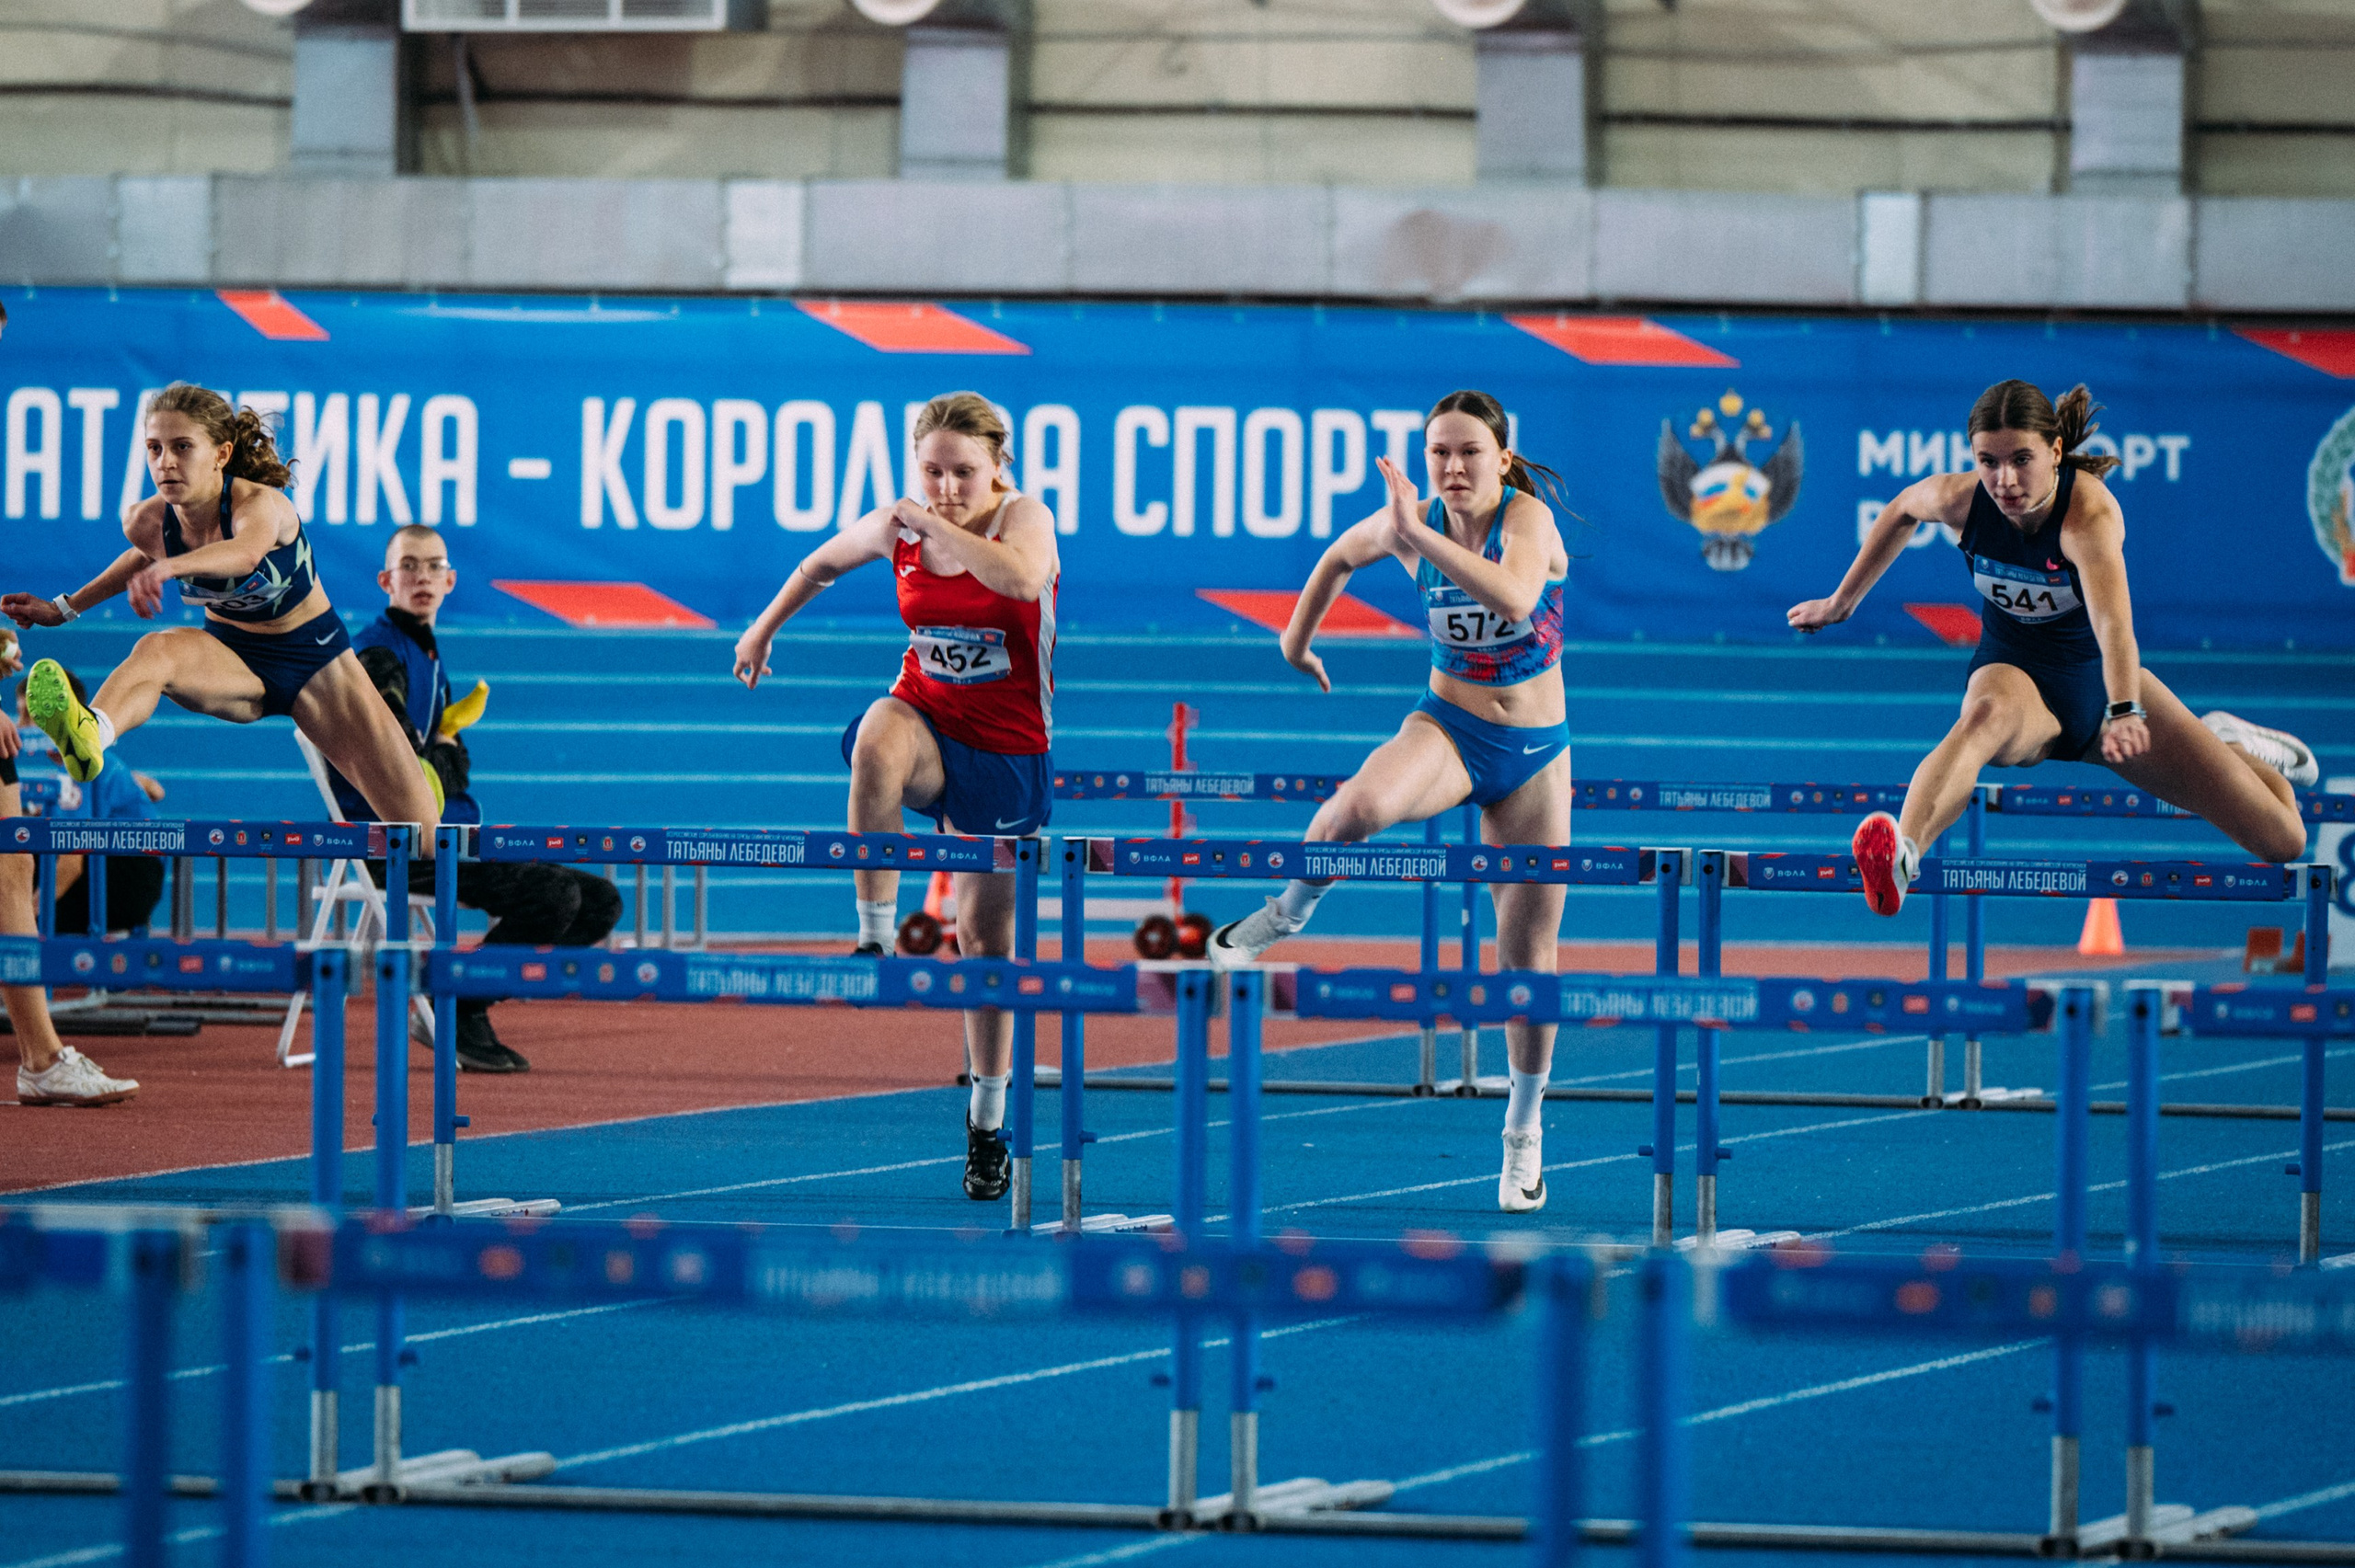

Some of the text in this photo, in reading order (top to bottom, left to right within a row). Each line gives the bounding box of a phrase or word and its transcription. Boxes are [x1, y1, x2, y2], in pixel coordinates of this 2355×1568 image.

[580, 396, 1082, 535] КОРОЛА
[1857, 429, 2191, 482] МИНОРТ
[205, 595, 266, 609] 03
[1992, 583, 2059, 612] 541
[1447, 612, 1515, 642] 572
[930, 644, 991, 673] 452
[51, 829, 185, 852] ТАТЬЯНЫ ЛЕБЕДЕВОЙ
[666, 841, 805, 864] ТАТЬЯНЫ ЛЕБЕДЕВОЙ
[1305, 855, 1447, 879] ТАТЬЯНЫ ЛЕБЕДЕВОЙ
[1943, 869, 2086, 892] ТАТЬЯНЫ ЛЕБЕДЕВОЙ
